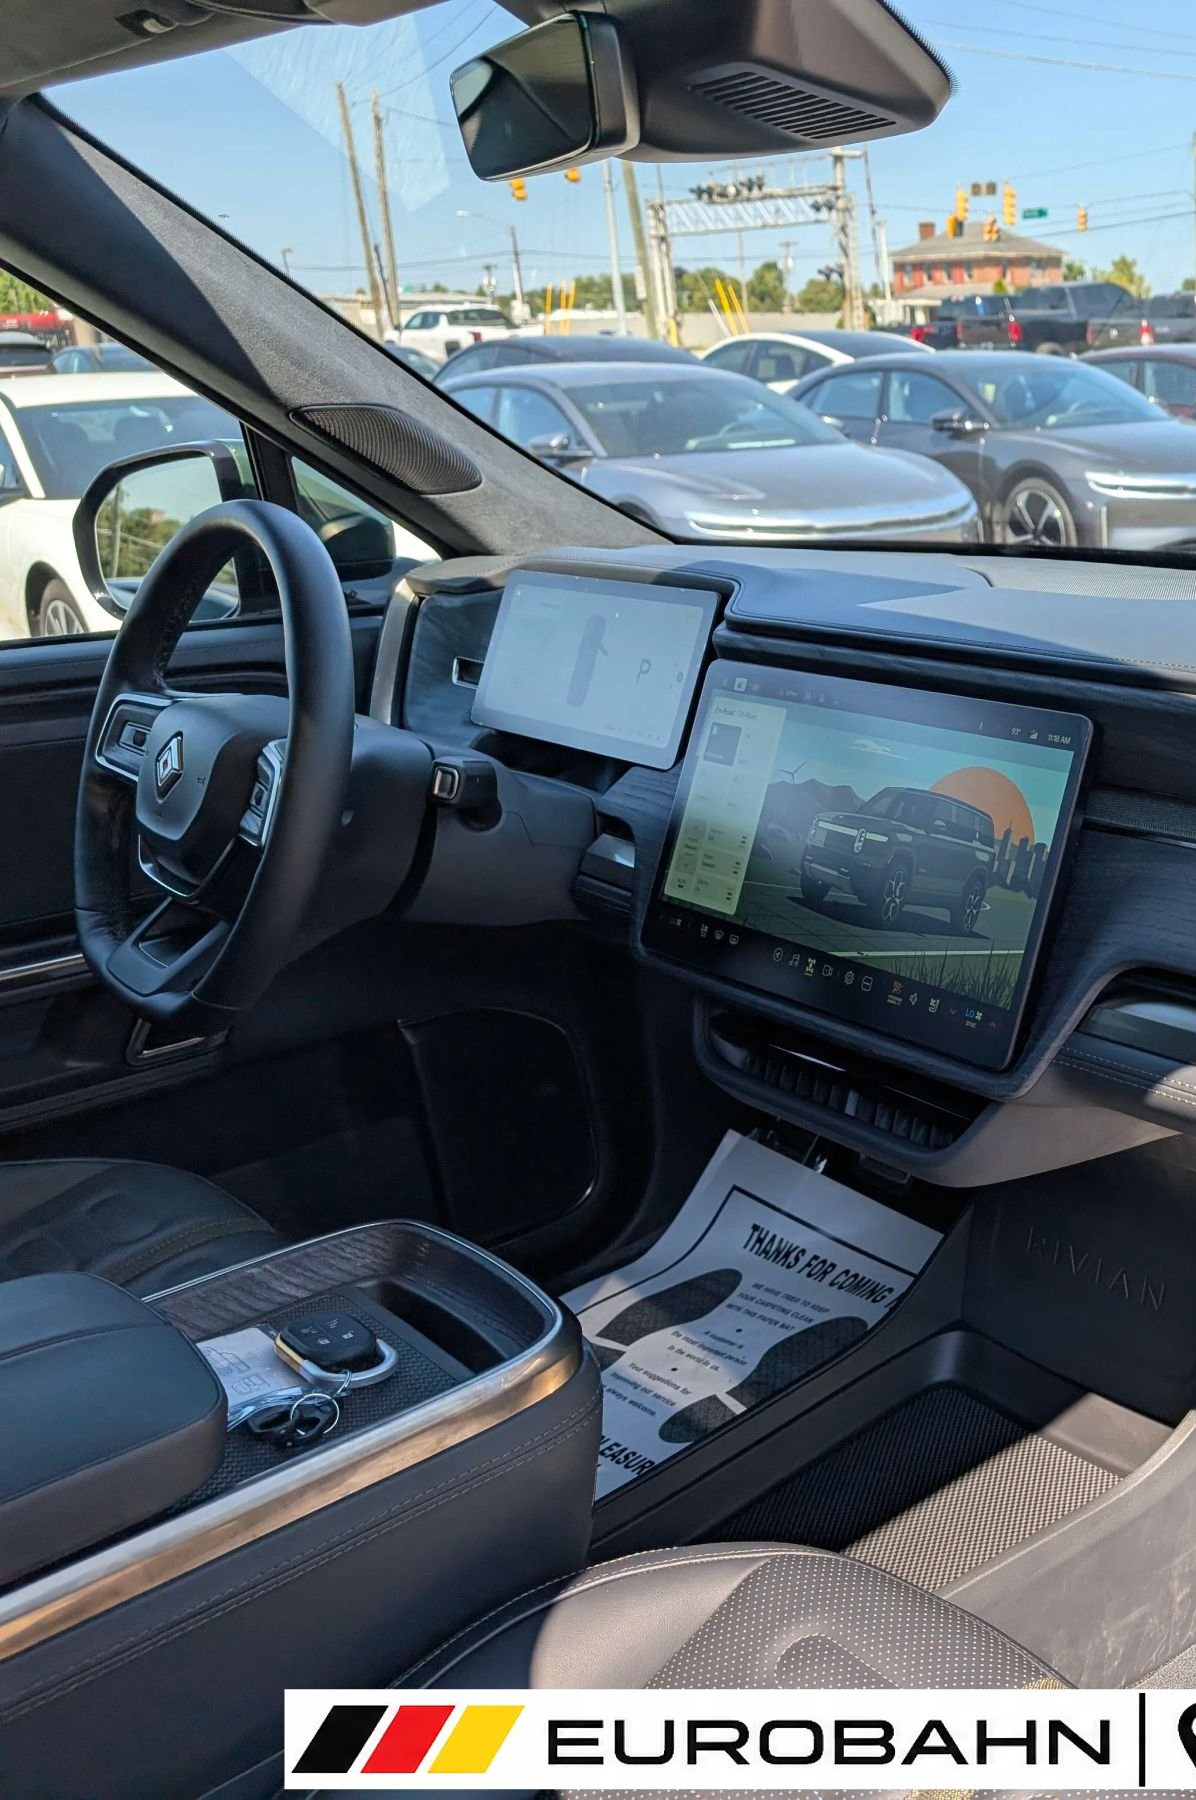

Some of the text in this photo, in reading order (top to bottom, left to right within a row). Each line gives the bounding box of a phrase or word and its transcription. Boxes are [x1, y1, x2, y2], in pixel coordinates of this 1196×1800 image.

[743, 1223, 894, 1304] THANKS FOR COMING
[1026, 1226, 1165, 1310] RIVIAN
